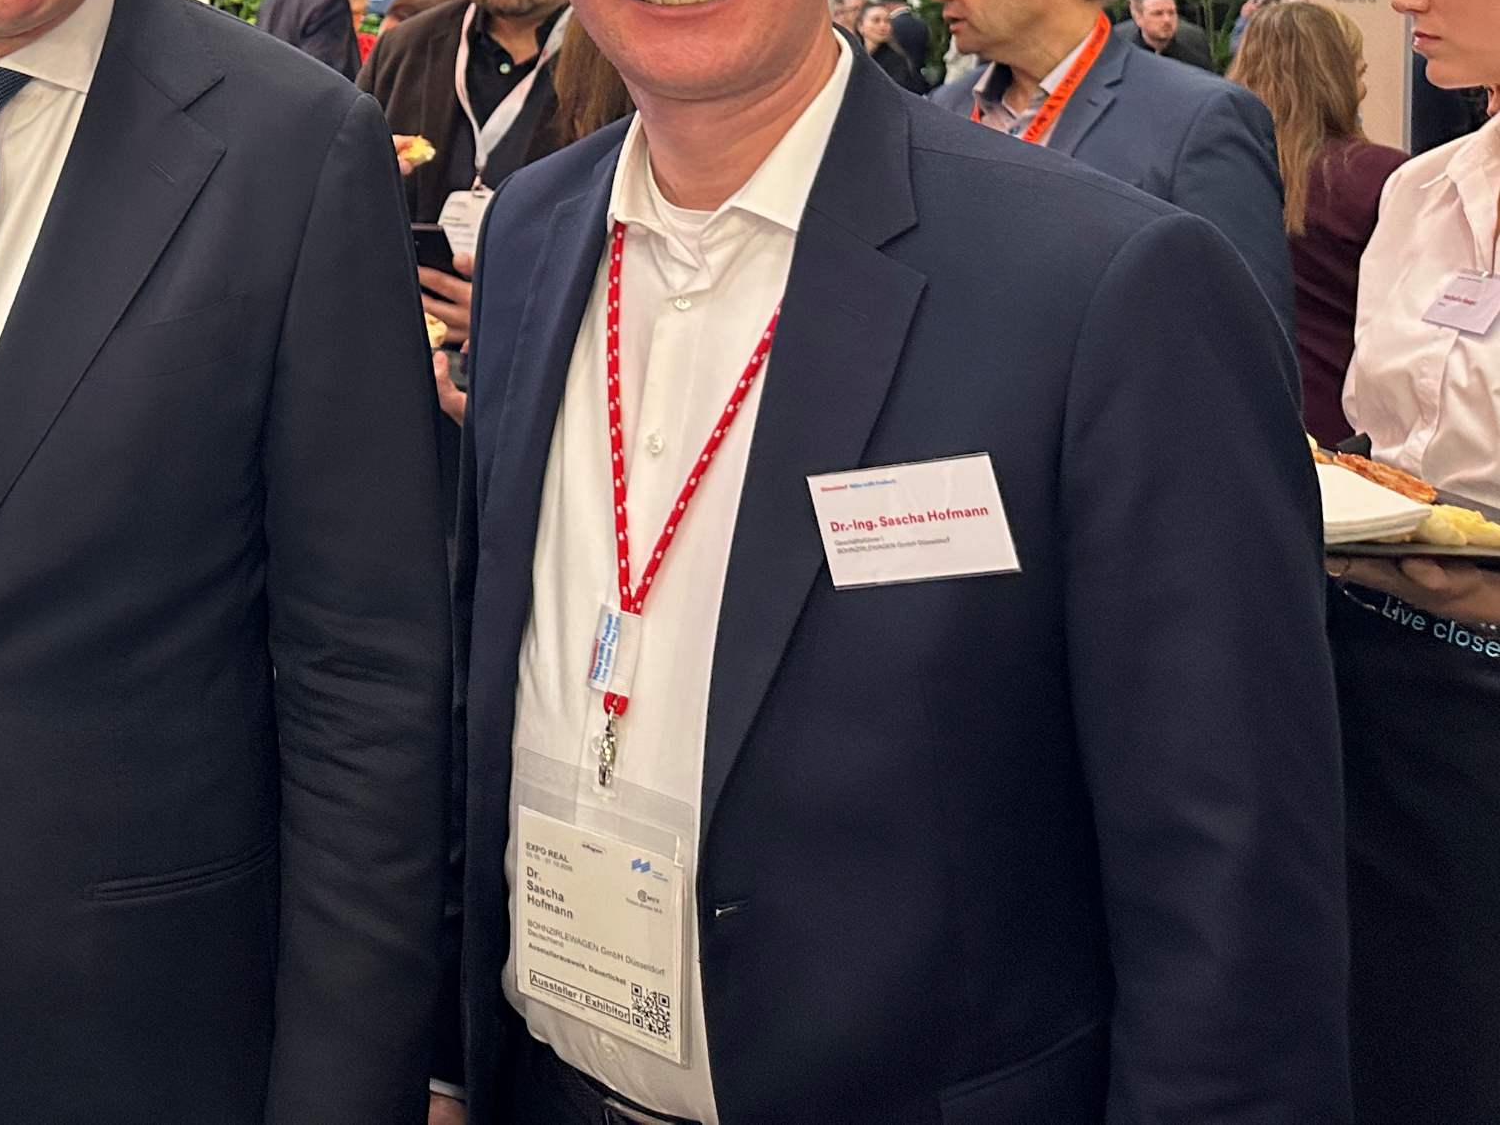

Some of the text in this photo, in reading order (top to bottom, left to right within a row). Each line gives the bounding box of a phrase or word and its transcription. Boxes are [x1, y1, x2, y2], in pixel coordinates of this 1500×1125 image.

[830, 506, 989, 533] Dr.-Ing. Sascha Hofmann
[1382, 596, 1426, 631] Live
[526, 842, 547, 855] EXPO
[548, 850, 569, 863] REAL
[526, 866, 541, 881] Dr.
[527, 879, 564, 902] Sascha
[527, 894, 573, 919] Hofmann
[532, 975, 578, 998] Aussteller
[585, 996, 628, 1019] Exhibitor
